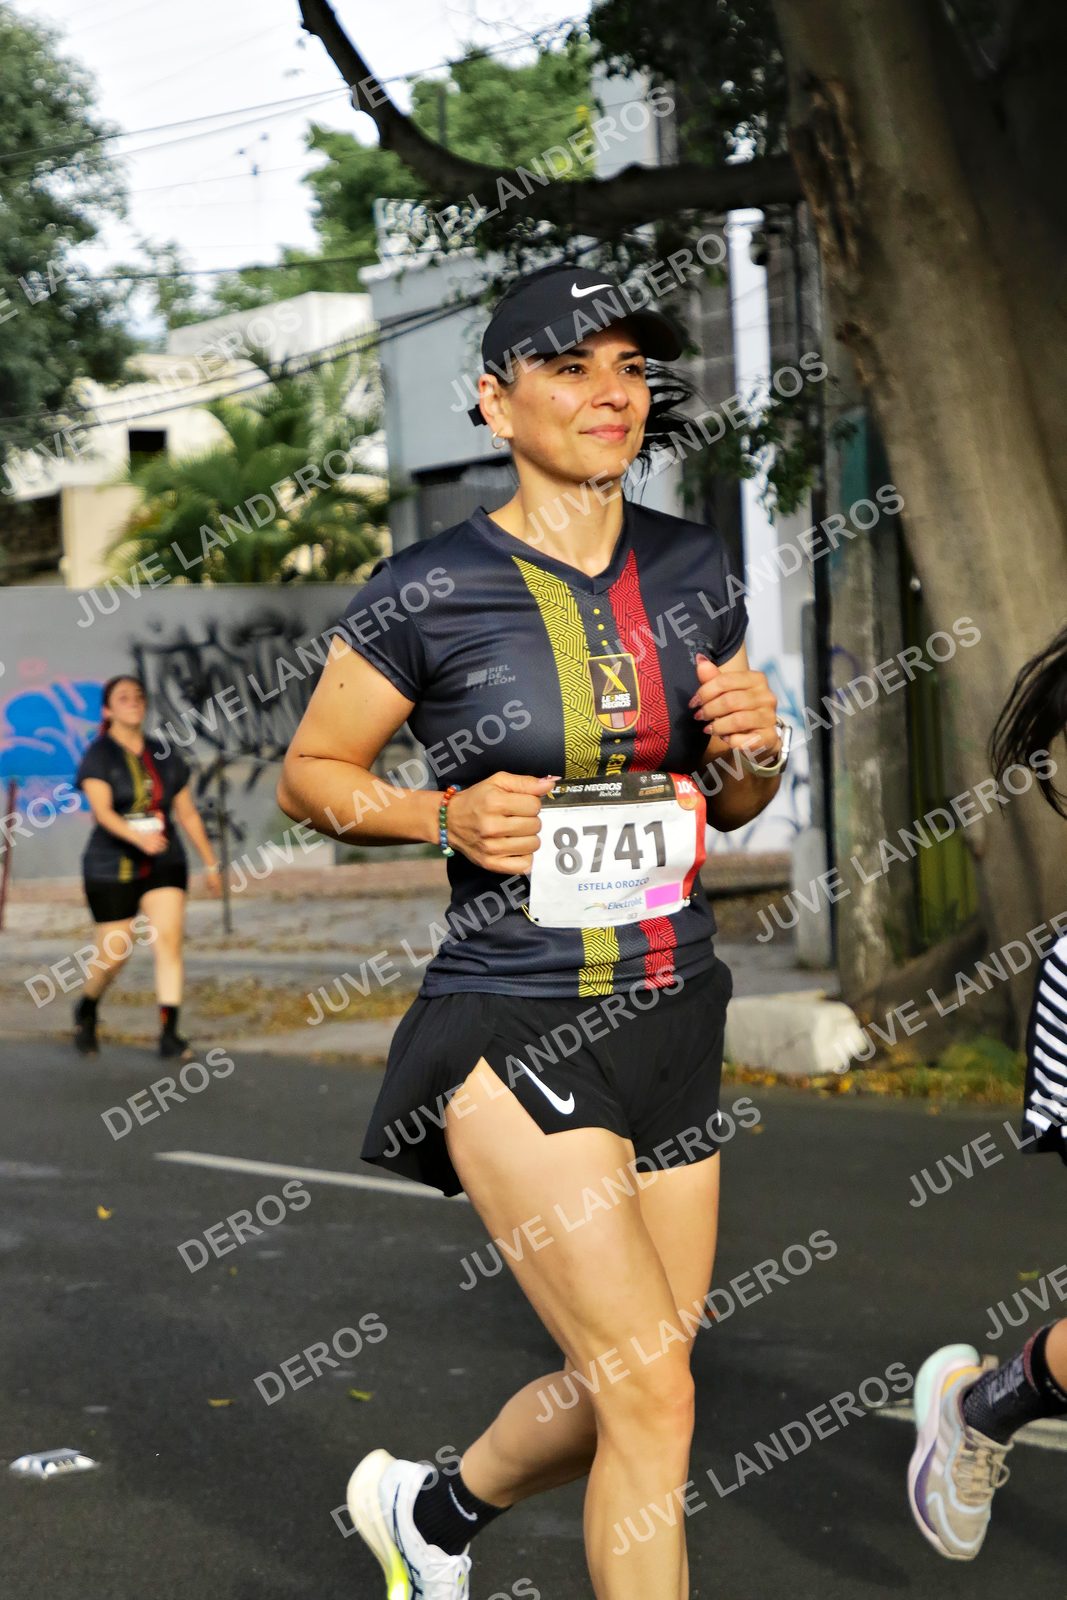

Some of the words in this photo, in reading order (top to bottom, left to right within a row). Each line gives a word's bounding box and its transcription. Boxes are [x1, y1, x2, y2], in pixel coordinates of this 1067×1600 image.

[601, 700, 631, 709] NEGROS
[584, 782, 622, 792] NEGROS
[553, 820, 667, 875] 8741
[577, 881, 613, 892] ESTELA
[615, 877, 650, 889] OROZCO
